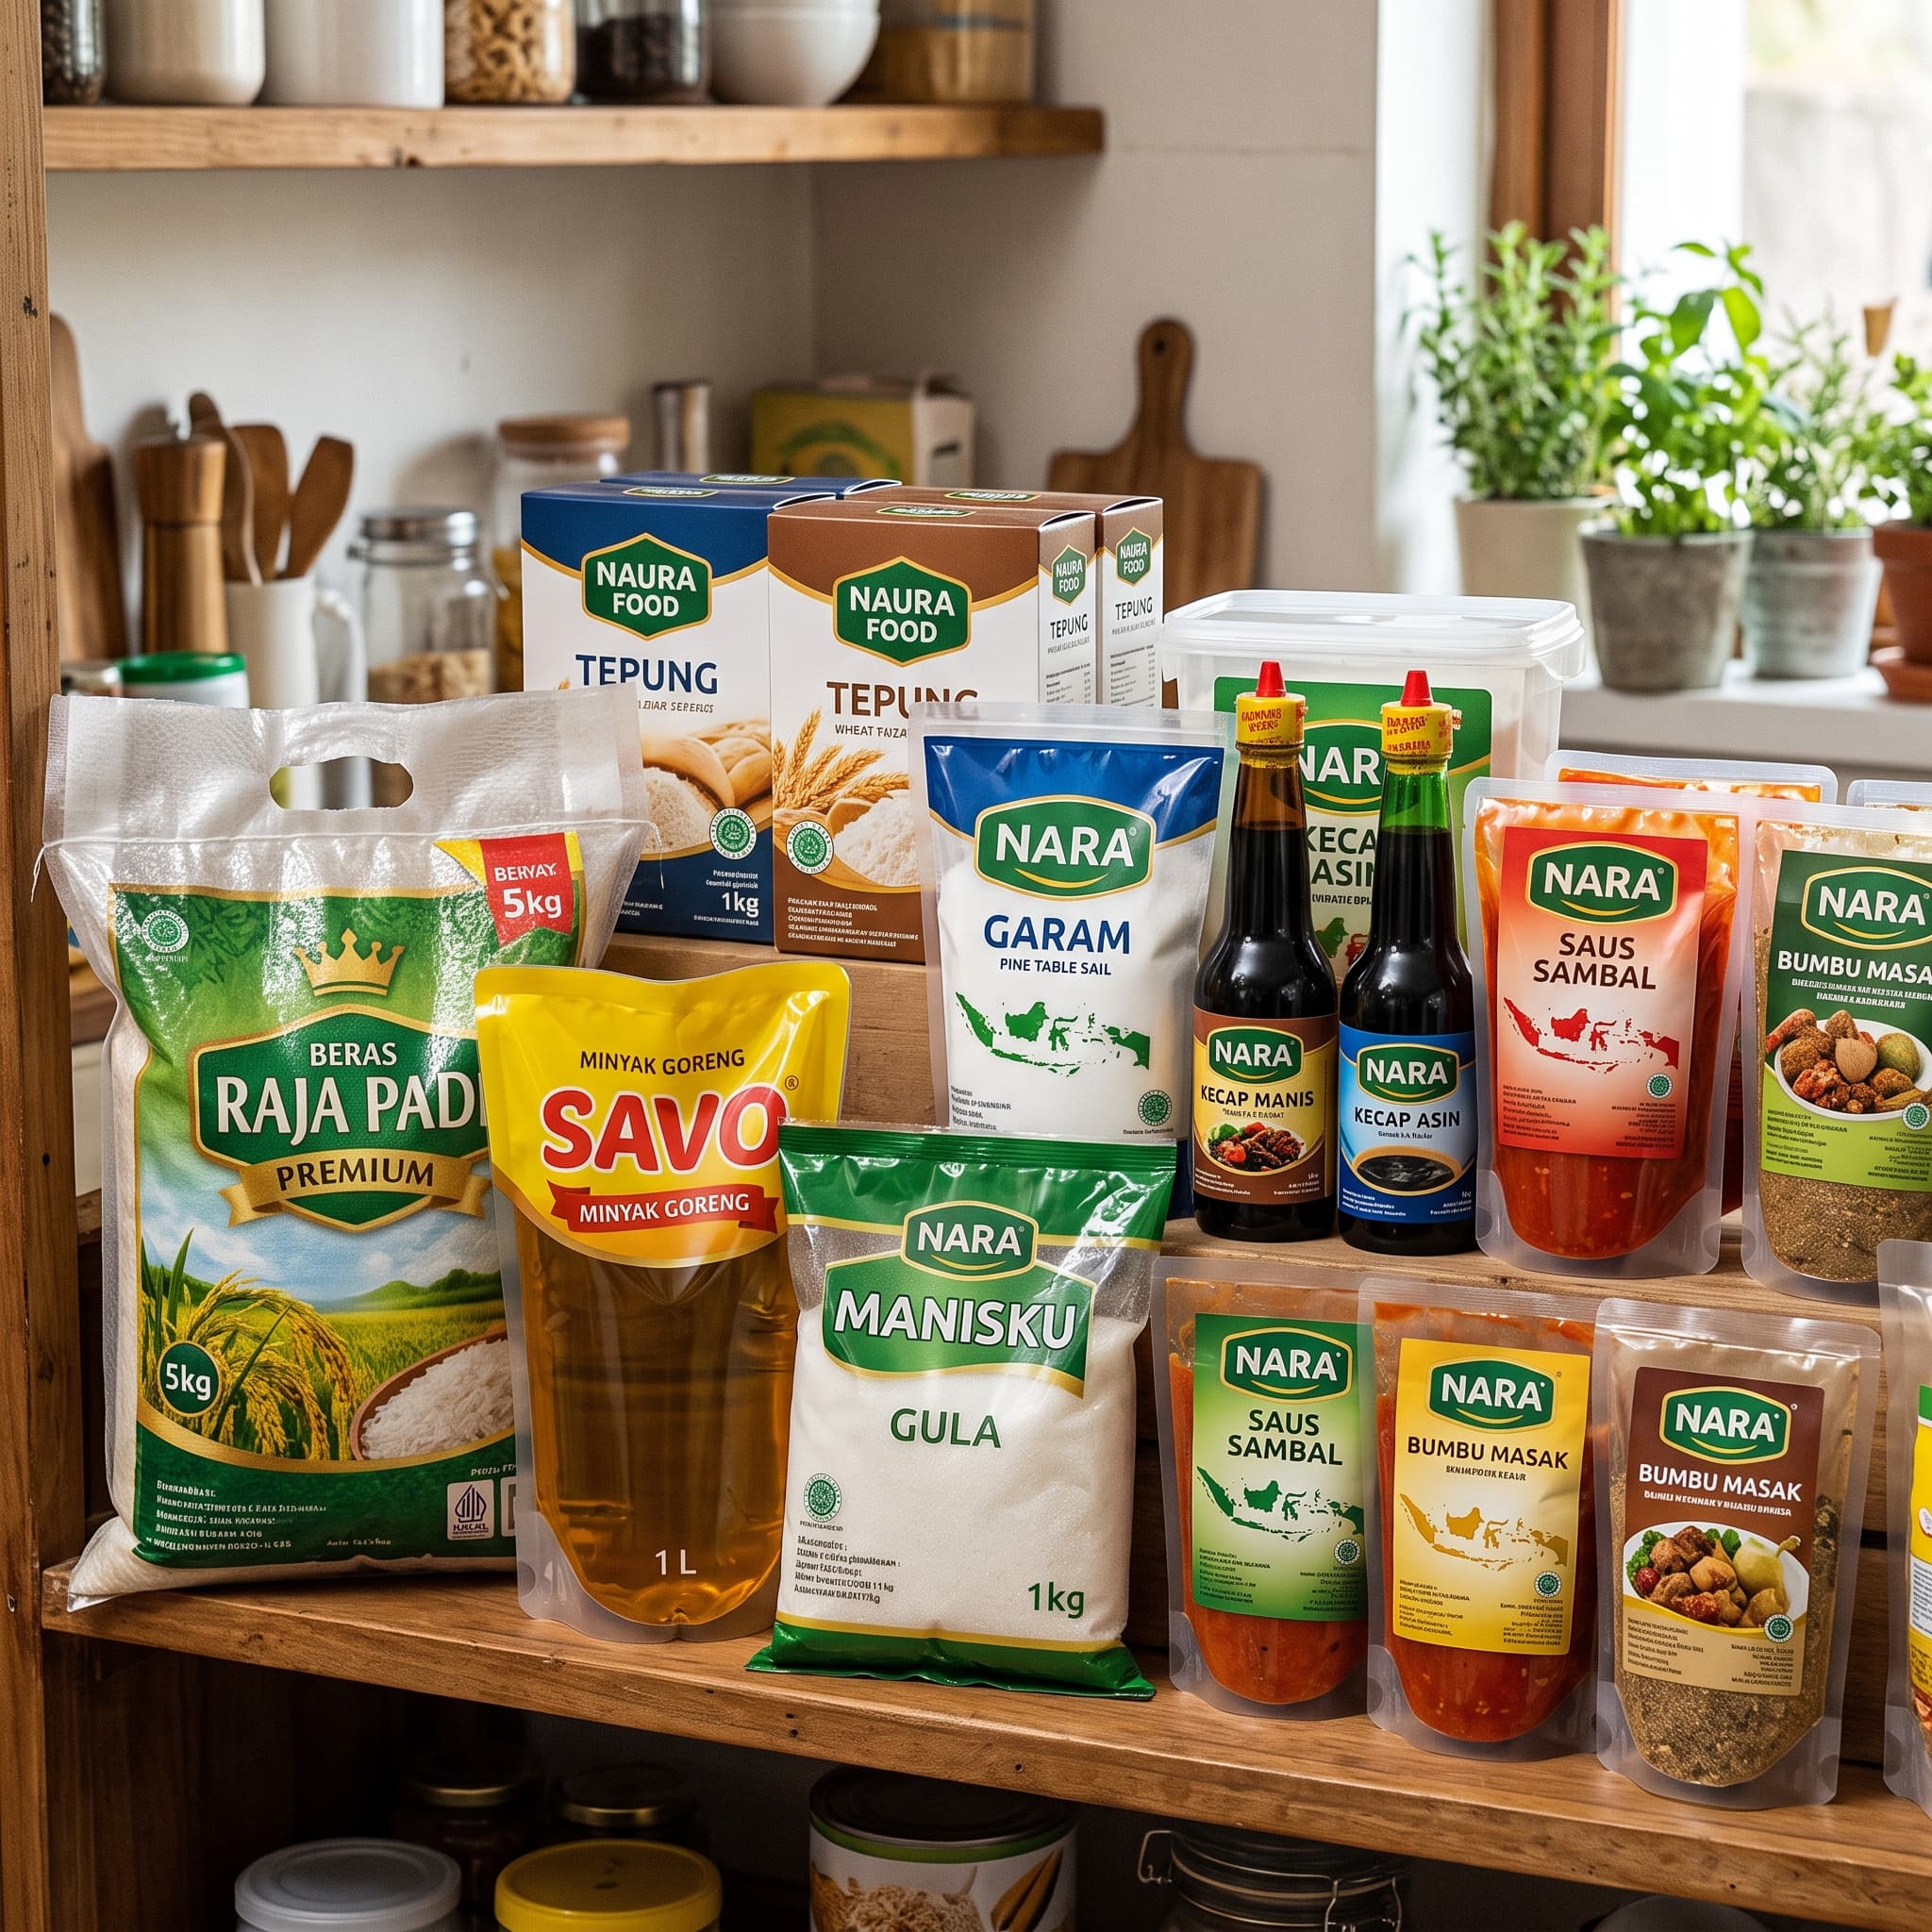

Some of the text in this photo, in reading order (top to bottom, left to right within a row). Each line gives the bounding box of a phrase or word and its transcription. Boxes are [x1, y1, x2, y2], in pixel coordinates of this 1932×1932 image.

[596, 561, 697, 591] NAURA
[1124, 558, 1145, 575] FOOD
[850, 585, 956, 616] NAURA
[1058, 577, 1080, 593] FOOD
[612, 592, 679, 617] FOOD
[1115, 596, 1153, 621] TEPUNG
[866, 618, 938, 643] FOOD
[1050, 613, 1089, 640] TEPUNG
[575, 654, 718, 694] TEPUNG
[835, 724, 874, 737] WHEAT
[1298, 745, 1382, 785] NAR
[996, 823, 1134, 867] NARA
[1306, 825, 1376, 855] KECA
[1543, 861, 1661, 902] NARA
[503, 887, 563, 920] 5kg
[722, 891, 759, 918] 1kg
[1818, 885, 1926, 926] NARA
[984, 914, 1130, 955] GARAM
[1558, 932, 1635, 960] SAUS
[1000, 958, 1111, 976] PINE TABLE SAIL
[1533, 958, 1657, 991] SAMBAL
[1777, 949, 1932, 986] BUMBU MASA
[309, 1041, 398, 1067] BERAS
[579, 1048, 745, 1075] MINYAK GORENG
[1214, 1038, 1293, 1067] NARA
[1366, 1057, 1449, 1085] NARA
[216, 1075, 351, 1147] RAJA
[1201, 1084, 1315, 1108] KECAP MANIS
[541, 1082, 789, 1174] SAVO
[1355, 1106, 1460, 1129] KECAP ASIN
[275, 1158, 435, 1191] PREMIUM
[578, 1192, 750, 1224] MINYAK GORENG
[917, 1221, 1022, 1257] NARA
[833, 1289, 1077, 1350] MANISKU
[1236, 1345, 1338, 1382] NARA
[165, 1362, 211, 1403] 5kg
[1441, 1373, 1542, 1412] NARA
[890, 1407, 1002, 1449] GULA
[1248, 1409, 1320, 1437] SAUS
[1674, 1403, 1775, 1442] NARA
[1227, 1434, 1343, 1466] SAMBAL
[1407, 1436, 1570, 1471] BUMBU MASAK
[1639, 1463, 1803, 1503] BUMBU MASAK
[655, 1548, 697, 1575] 1 L
[1027, 1581, 1086, 1620] 1kg
